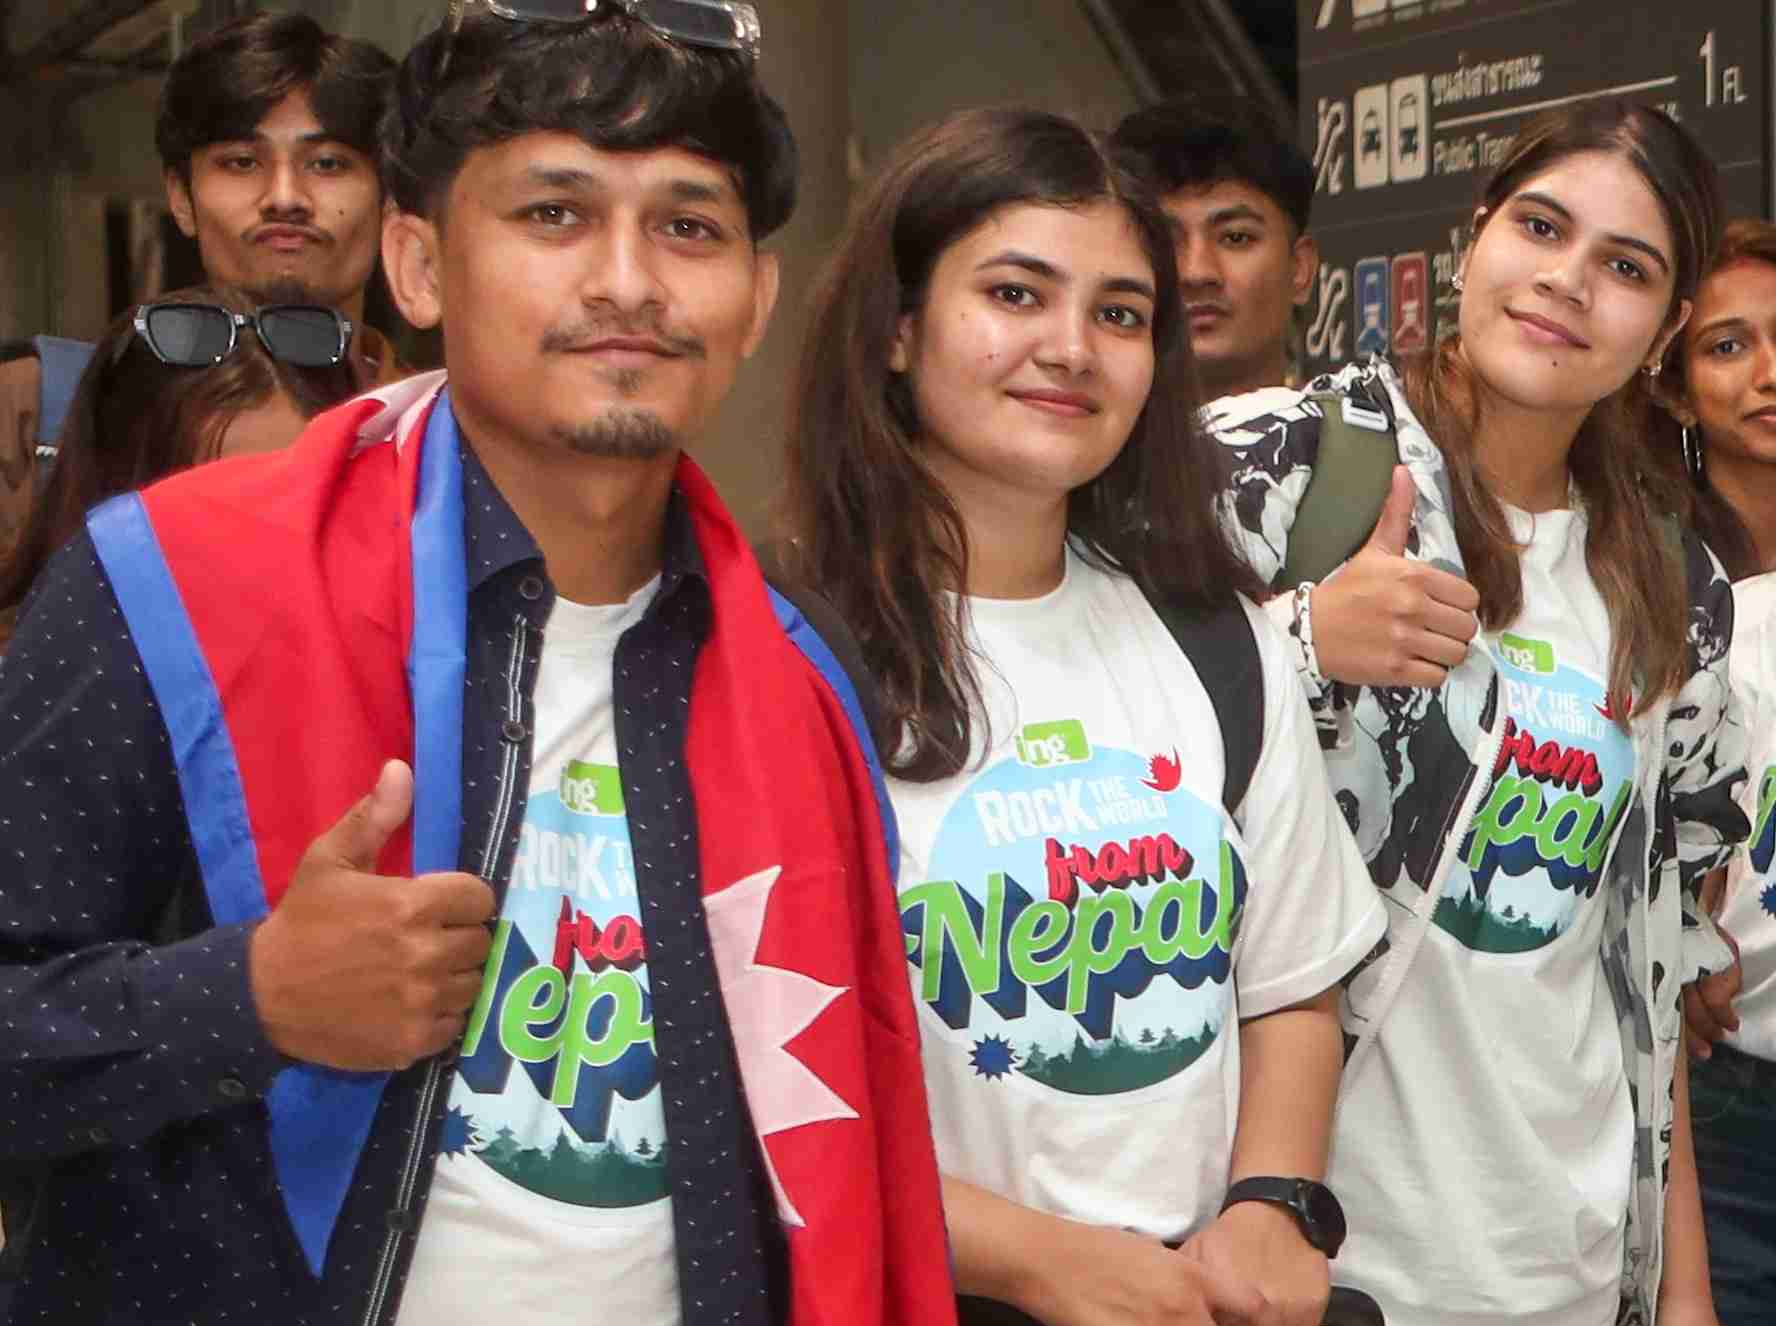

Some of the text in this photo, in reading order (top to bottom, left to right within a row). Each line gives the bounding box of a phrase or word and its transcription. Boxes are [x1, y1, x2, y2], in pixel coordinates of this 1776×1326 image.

[1700, 30, 1749, 107] 1 FL
[1433, 135, 1474, 176] Public
[1507, 680, 1551, 729] CK
[1549, 688, 1582, 714] THE
[972, 777, 1099, 848] ROCK
[1087, 775, 1131, 804] THE
[1096, 794, 1170, 828] WORLD
[1468, 776, 1634, 873] pal
[1045, 832, 1193, 908] from
[552, 894, 647, 974] fro
[900, 839, 1238, 1016] Nepal
